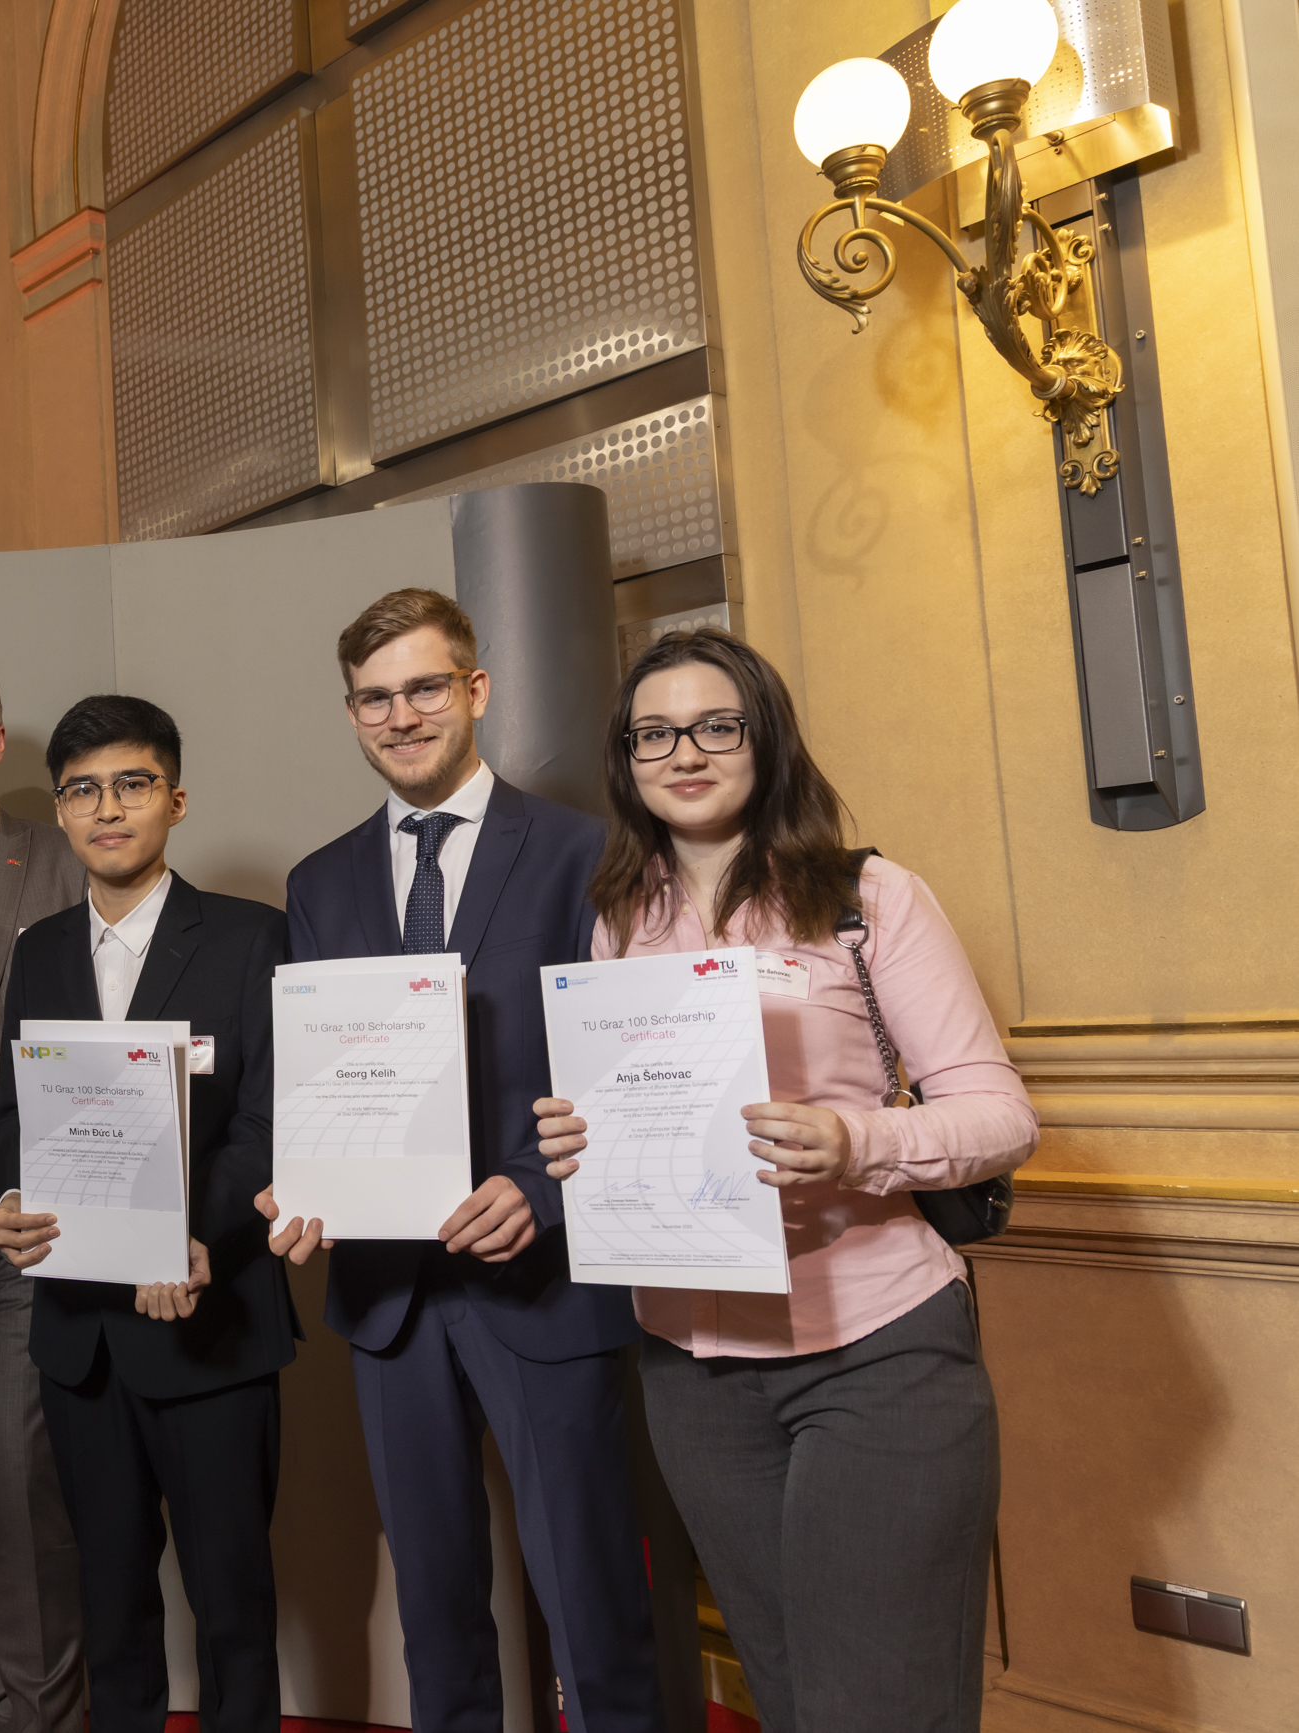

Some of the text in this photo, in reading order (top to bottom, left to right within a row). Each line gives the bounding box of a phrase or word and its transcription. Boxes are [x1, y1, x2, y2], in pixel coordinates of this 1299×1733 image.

[719, 961, 734, 970] TU
[304, 1021, 425, 1033] TU Graz 100 Scholarship
[582, 1012, 716, 1032] TU Graz 100 Scholarship
[339, 1034, 390, 1044] Certificate
[621, 1029, 676, 1042] Certificate
[20, 1046, 50, 1059] NXP
[336, 1068, 396, 1081] Georg Kelih
[616, 1067, 692, 1086] Anja Šehovac
[95, 1087, 144, 1098] Scholarship
[72, 1097, 114, 1106] Certificate
[69, 1128, 90, 1136] Minh
[92, 1129, 110, 1137] Đức
